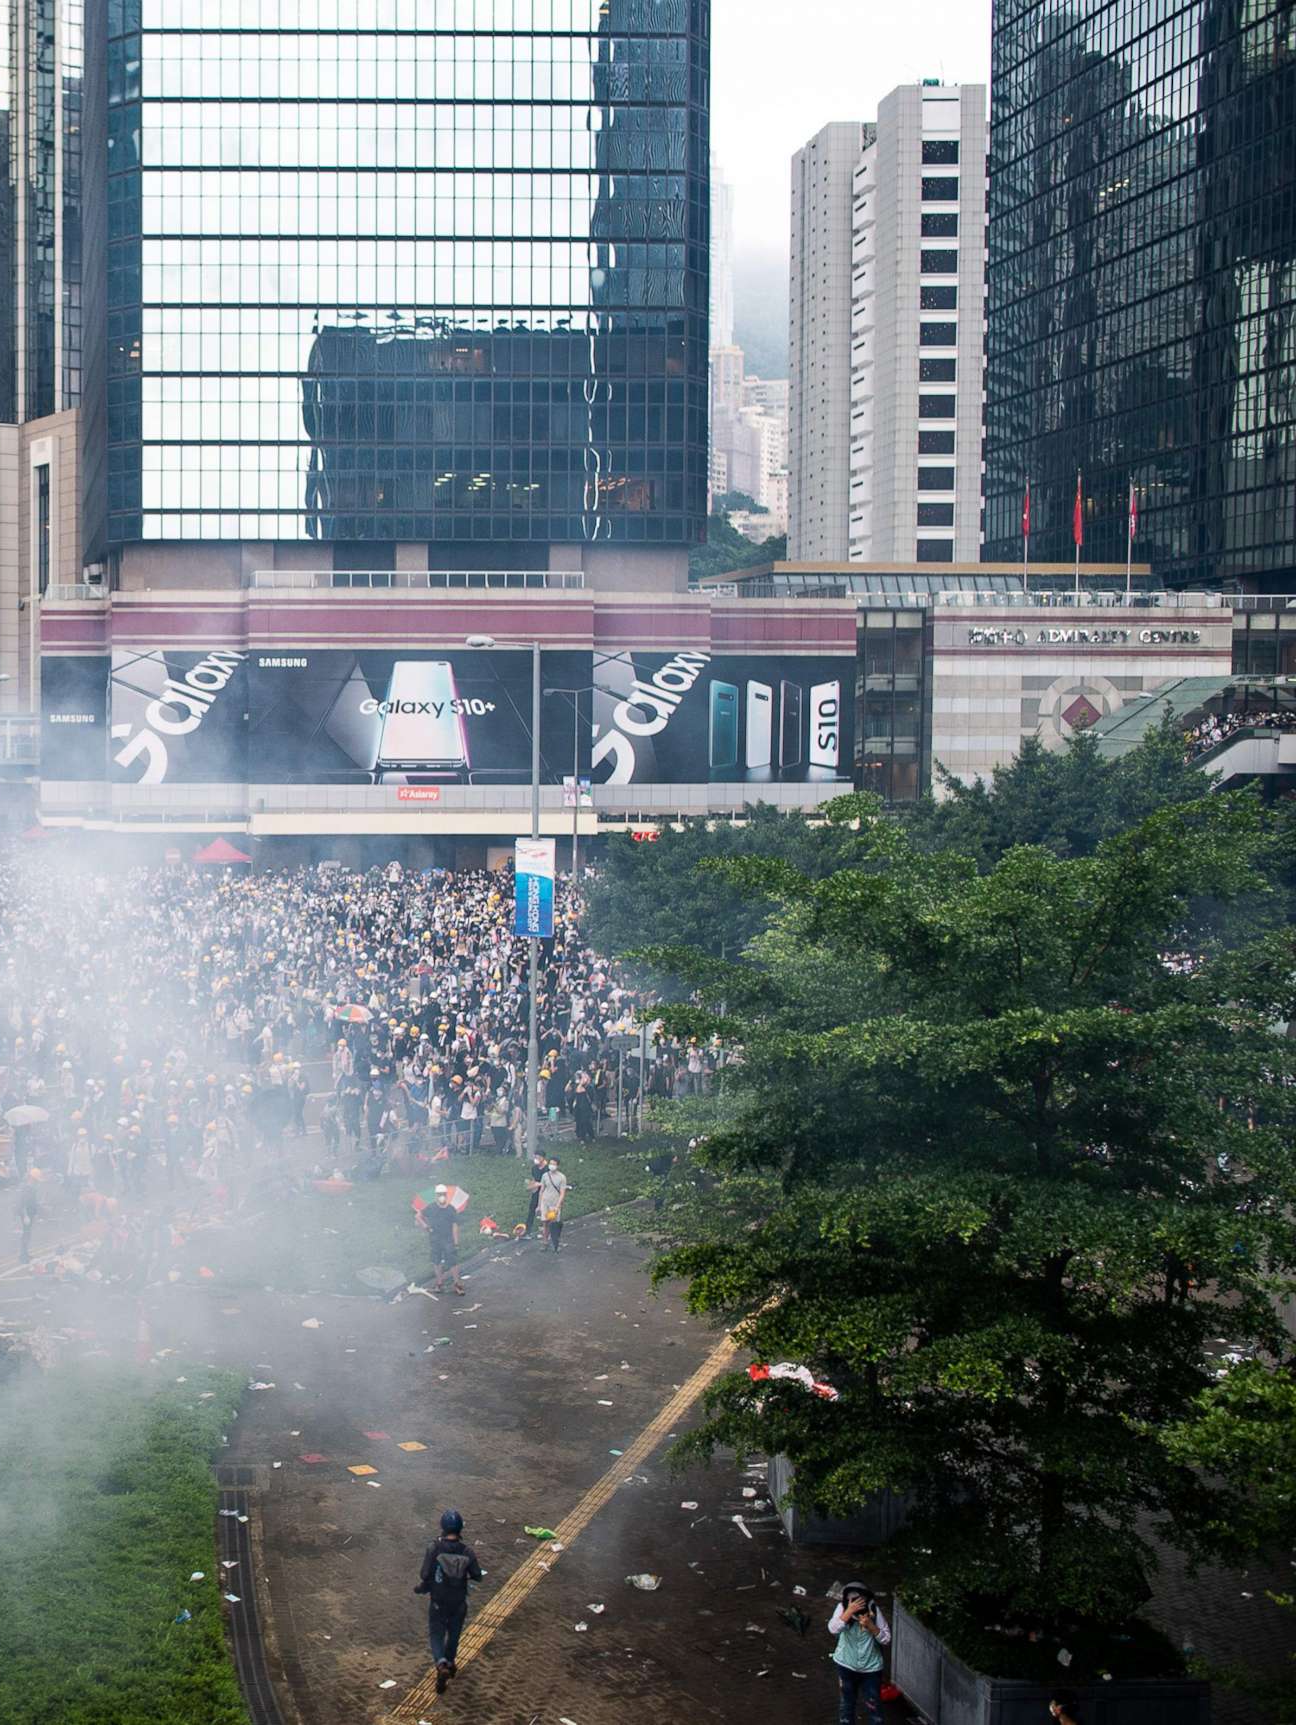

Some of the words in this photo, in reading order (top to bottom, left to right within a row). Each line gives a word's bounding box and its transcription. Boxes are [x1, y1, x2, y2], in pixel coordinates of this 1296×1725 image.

[1037, 629, 1132, 643] ADMIRALTY
[1138, 629, 1201, 643] CENTRE
[258, 657, 307, 667] SAMSUNG
[359, 698, 445, 719] Galaxy
[450, 698, 496, 715] S10+
[49, 714, 95, 723] SAMSUNG
[818, 699, 838, 752] S10
